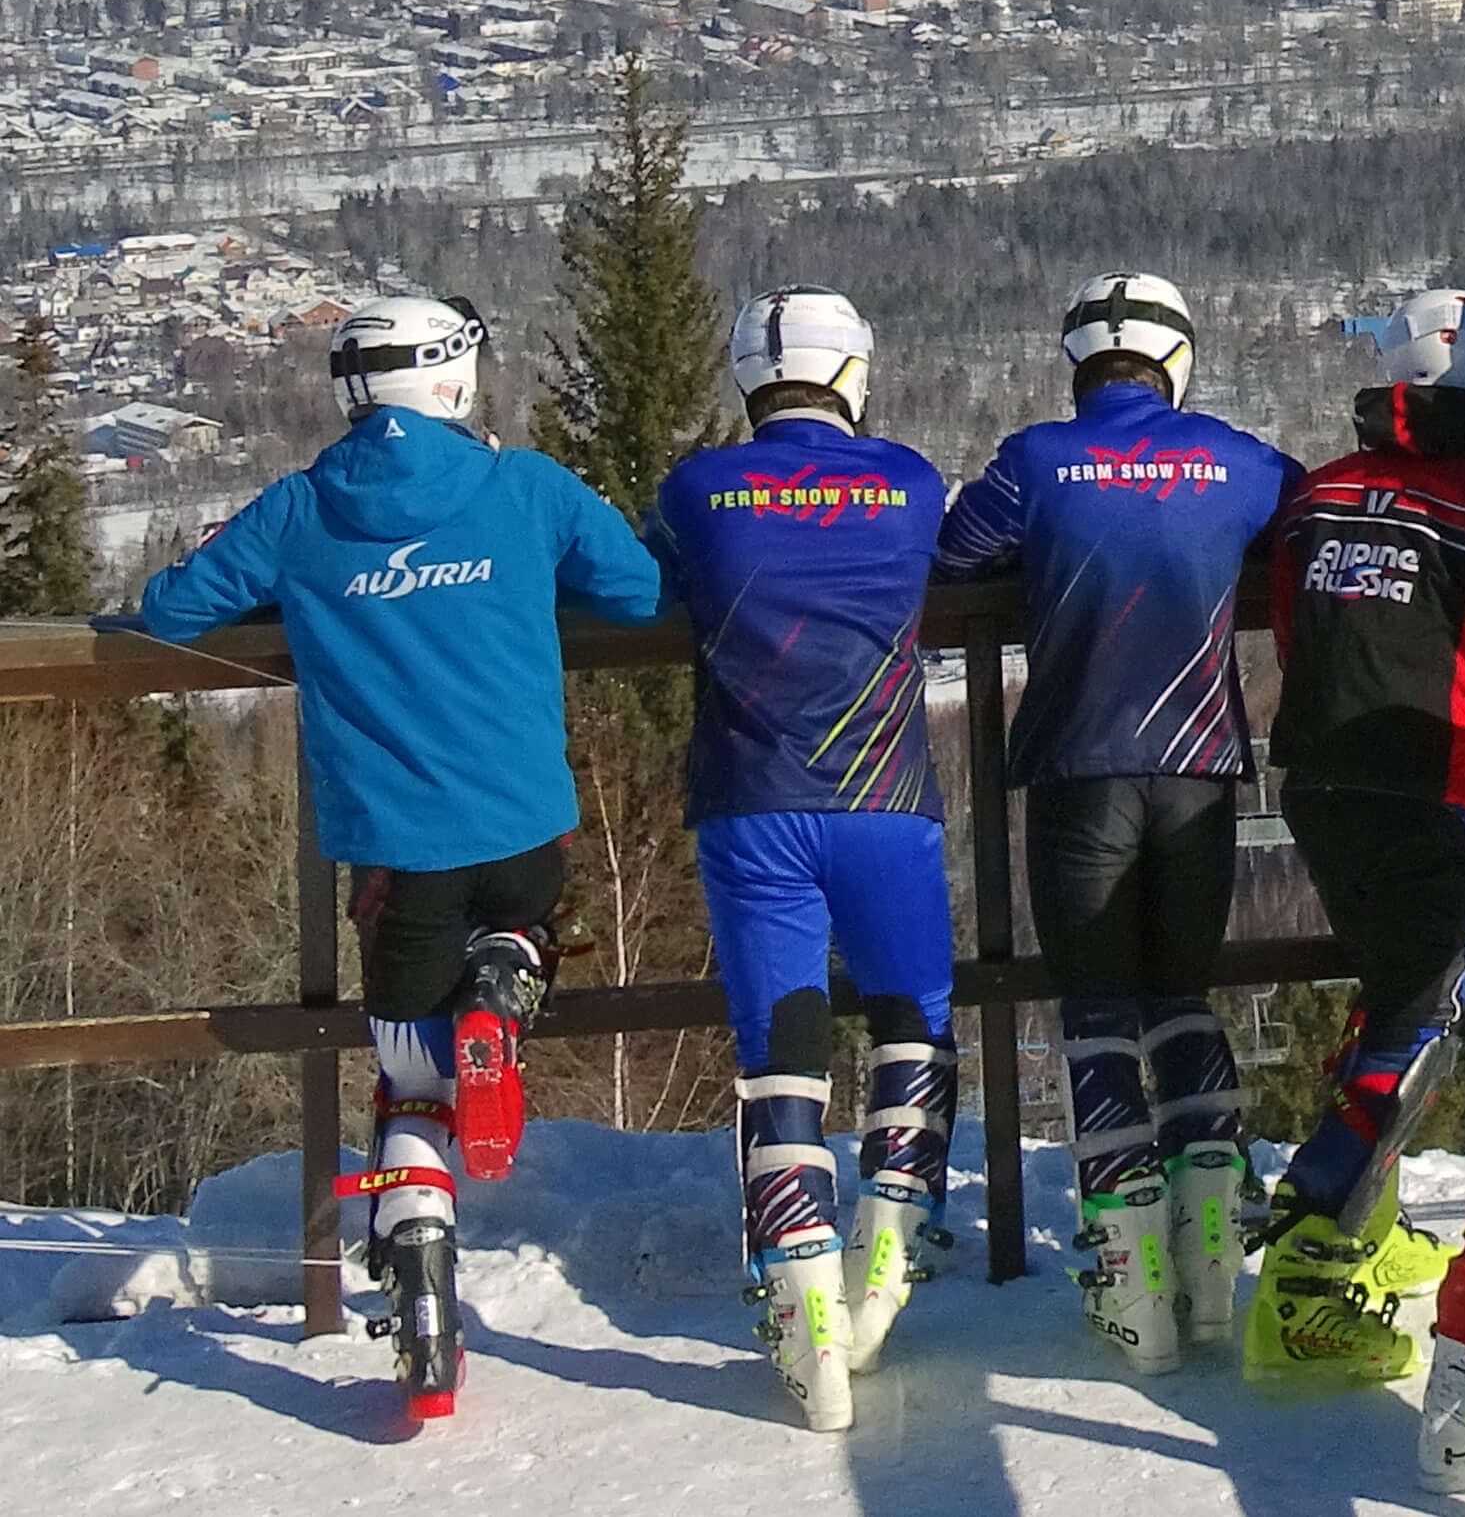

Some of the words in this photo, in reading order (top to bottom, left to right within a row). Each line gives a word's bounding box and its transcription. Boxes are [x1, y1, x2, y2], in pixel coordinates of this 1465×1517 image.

[415, 319, 484, 367] POC
[1056, 463, 1113, 483] PERM
[1121, 462, 1174, 480] SNOW
[1181, 463, 1227, 483] TEAM
[709, 489, 771, 510] PERM
[779, 488, 841, 505] SNOW
[850, 488, 907, 506] TEAM
[343, 541, 492, 599] AUSTRIA
[359, 1169, 409, 1189] LEKI
